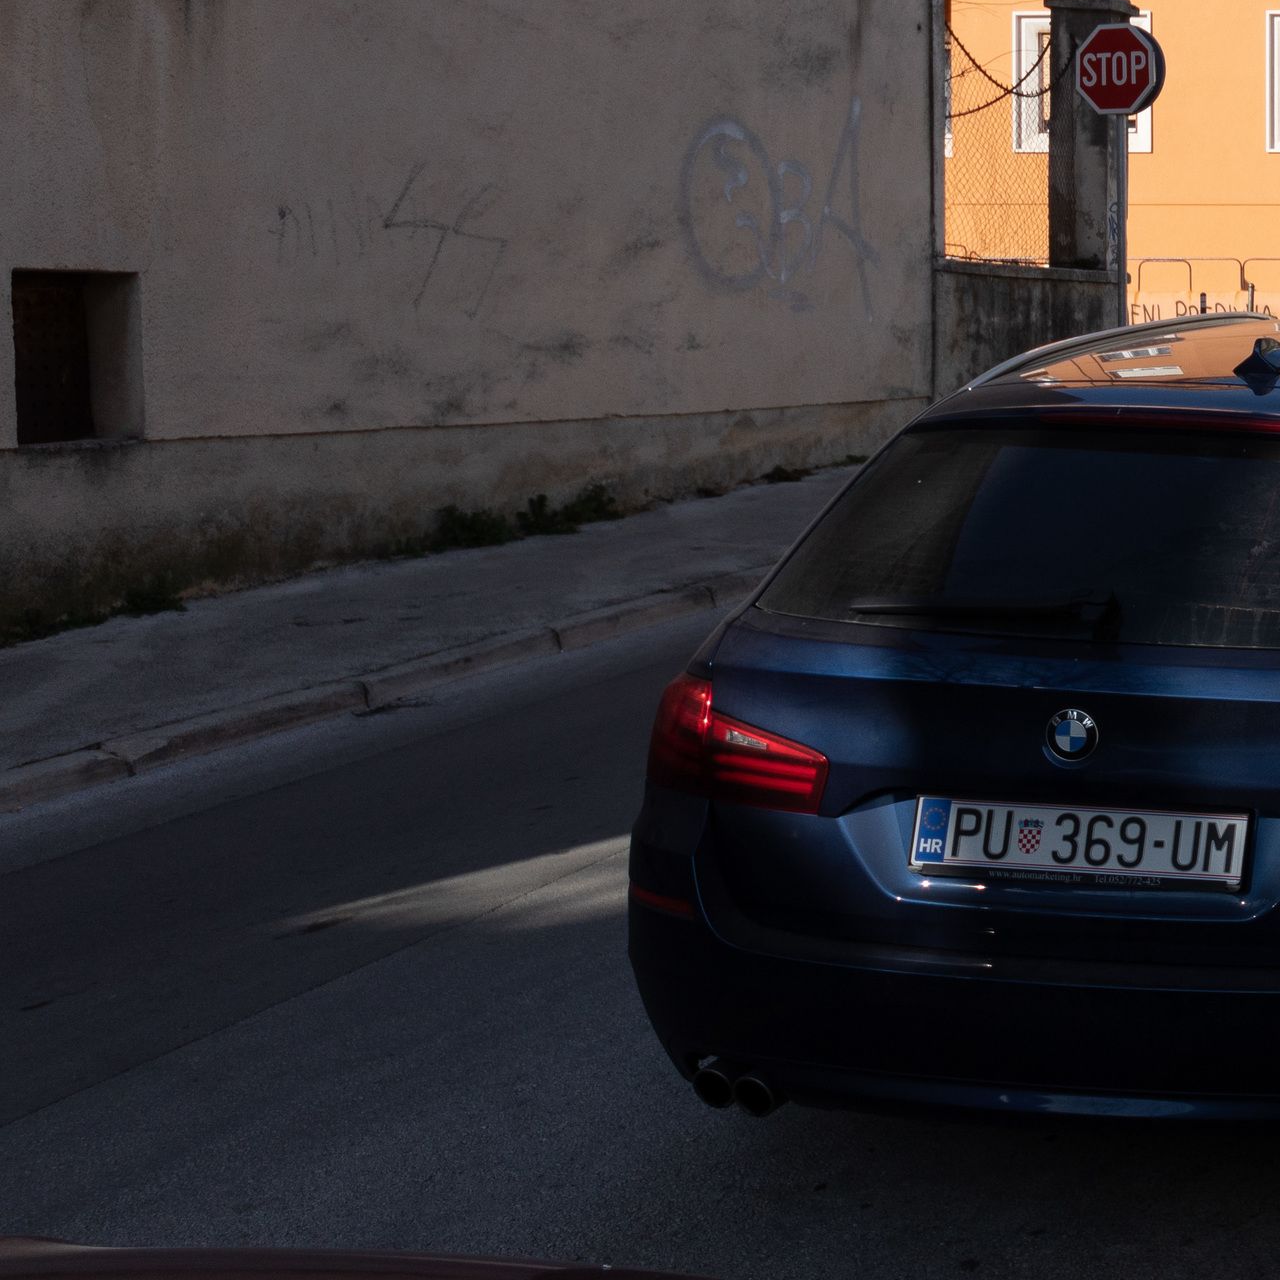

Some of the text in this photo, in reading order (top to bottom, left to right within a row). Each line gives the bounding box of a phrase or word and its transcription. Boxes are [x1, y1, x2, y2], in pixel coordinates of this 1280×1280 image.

[1082, 50, 1147, 87] STOP
[1051, 710, 1094, 729] BMW
[919, 837, 943, 855] HR
[951, 807, 1237, 873] PU 369-UM
